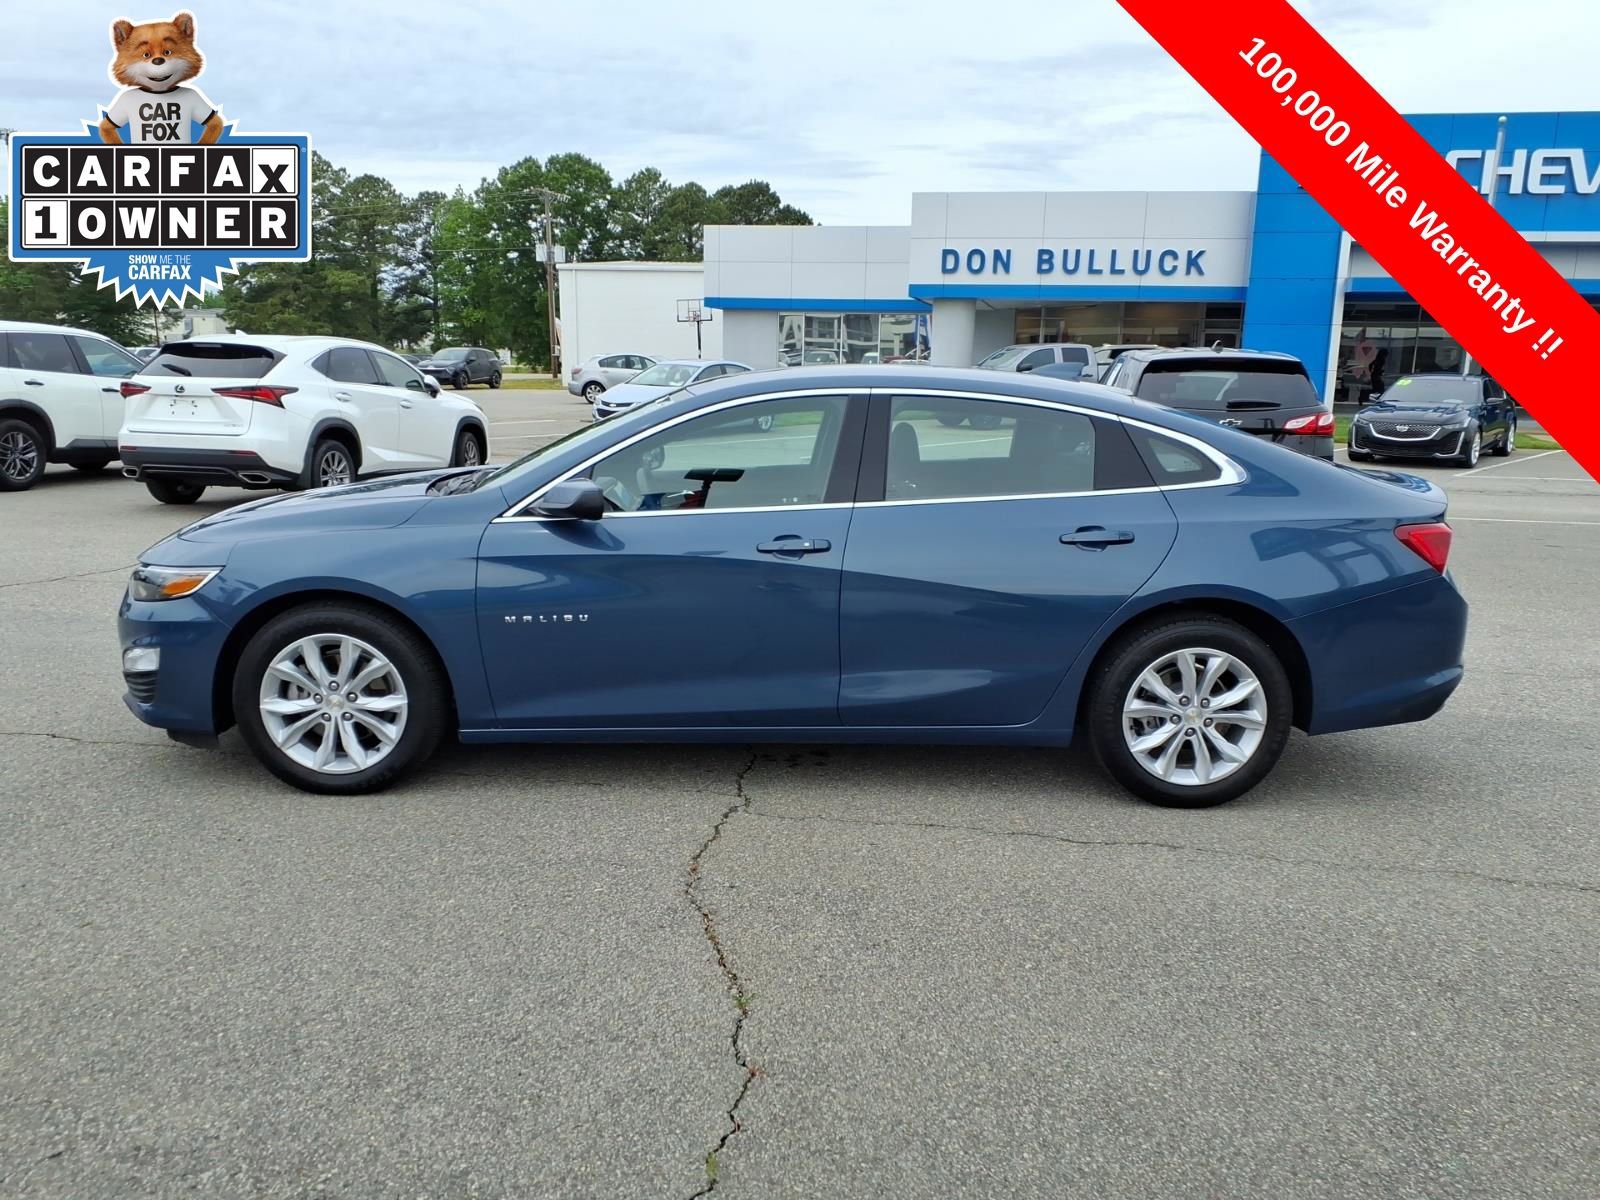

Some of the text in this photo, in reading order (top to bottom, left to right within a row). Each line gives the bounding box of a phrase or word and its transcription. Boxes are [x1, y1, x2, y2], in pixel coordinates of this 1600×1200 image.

[941, 248, 1207, 277] DON BULLUCK
[504, 614, 589, 623] MALIBU
